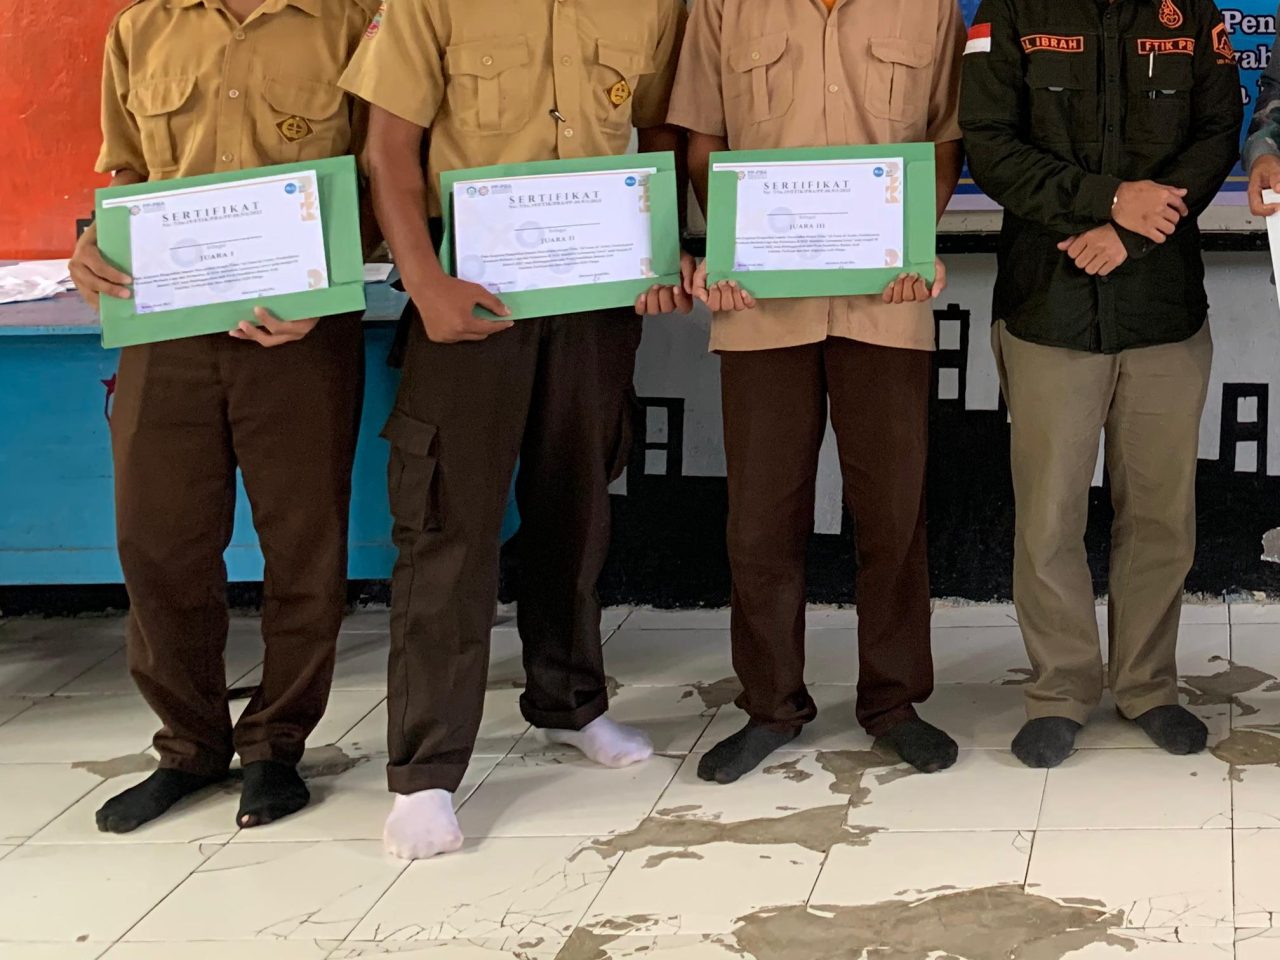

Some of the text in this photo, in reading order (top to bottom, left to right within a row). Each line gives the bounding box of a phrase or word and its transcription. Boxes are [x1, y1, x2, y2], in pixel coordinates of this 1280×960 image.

[1036, 37, 1077, 49] IBRAH
[1145, 41, 1173, 51] FTIK
[763, 180, 849, 190] SERTIFIKAT
[509, 191, 600, 204] SERTIFIKAT
[162, 201, 260, 223] SERTIFIKAT
[200, 252, 228, 261] JUARA
